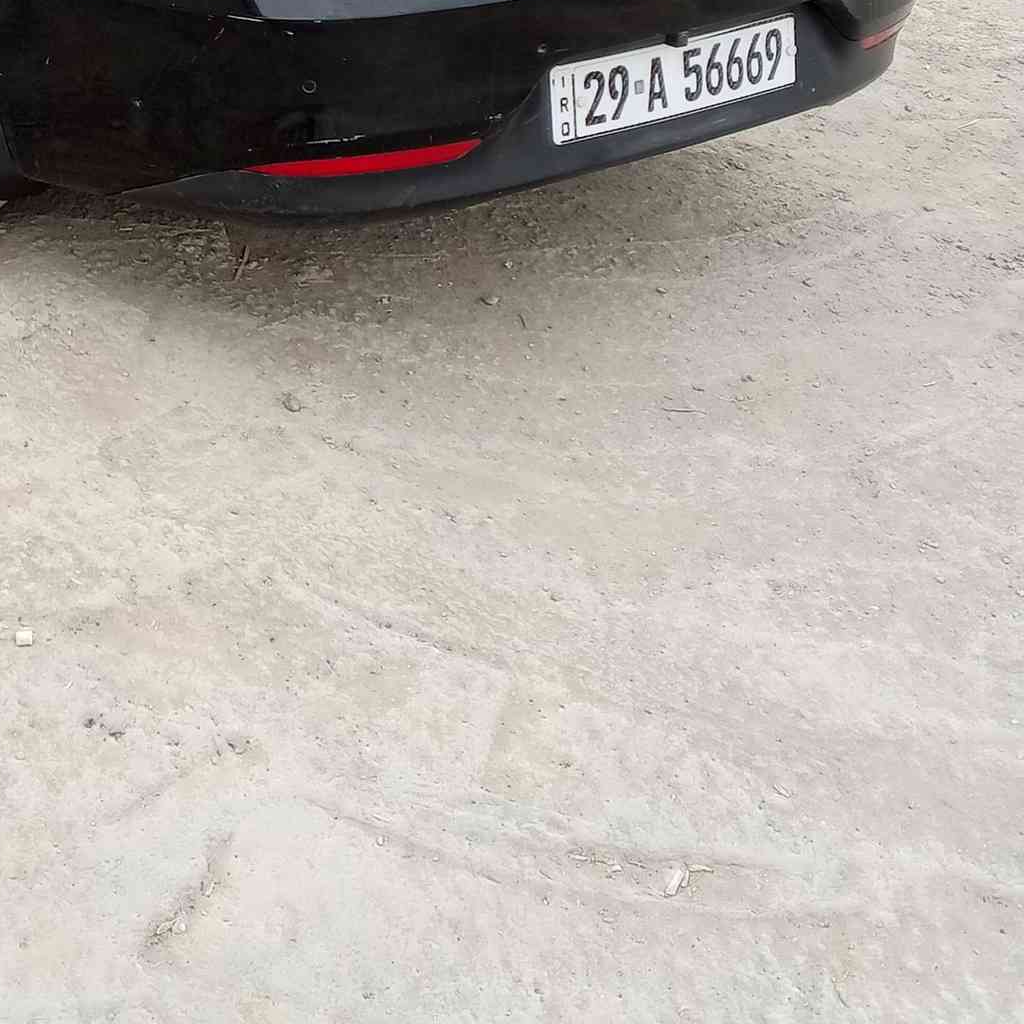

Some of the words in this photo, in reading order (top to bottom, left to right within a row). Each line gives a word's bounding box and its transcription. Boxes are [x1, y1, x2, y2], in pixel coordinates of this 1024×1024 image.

[584, 65, 628, 126] 29
[648, 57, 668, 112] A
[682, 29, 782, 101] 56669
